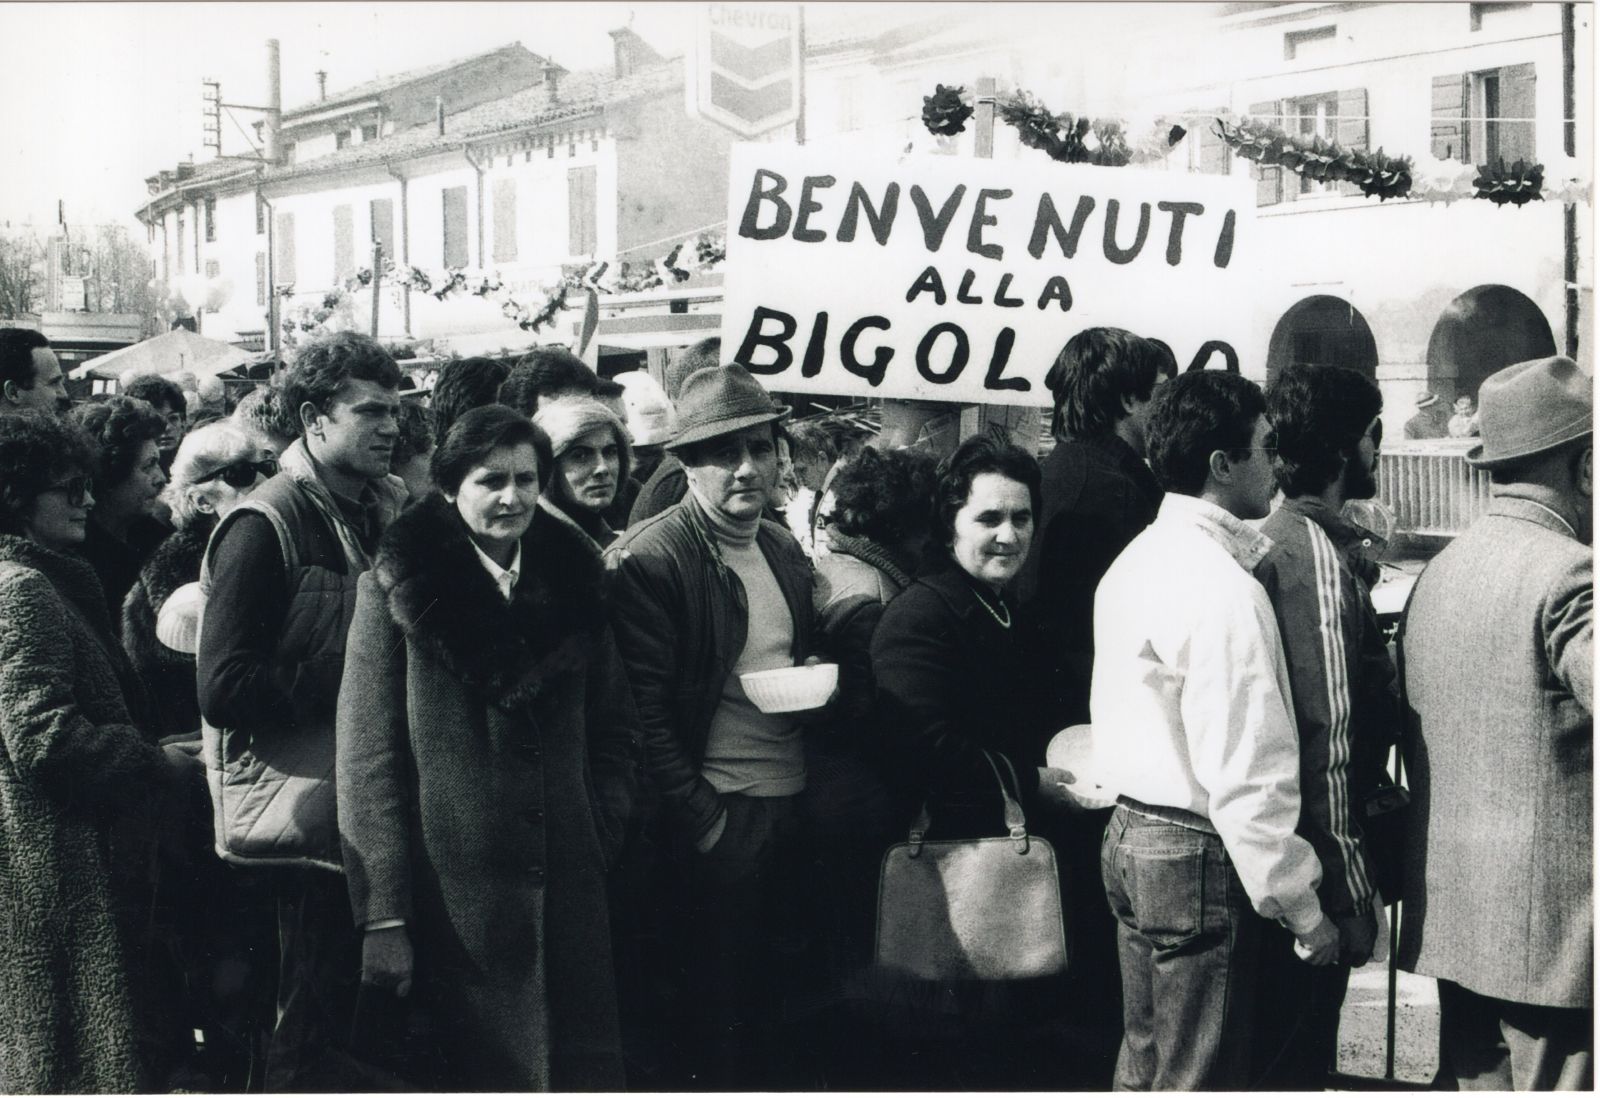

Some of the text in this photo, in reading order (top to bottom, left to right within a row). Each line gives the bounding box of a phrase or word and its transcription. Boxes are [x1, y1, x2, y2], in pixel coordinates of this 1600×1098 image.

[738, 168, 1236, 268] BENVENUTI
[905, 265, 1073, 312] ALLA
[733, 305, 1240, 392] BIGOL
